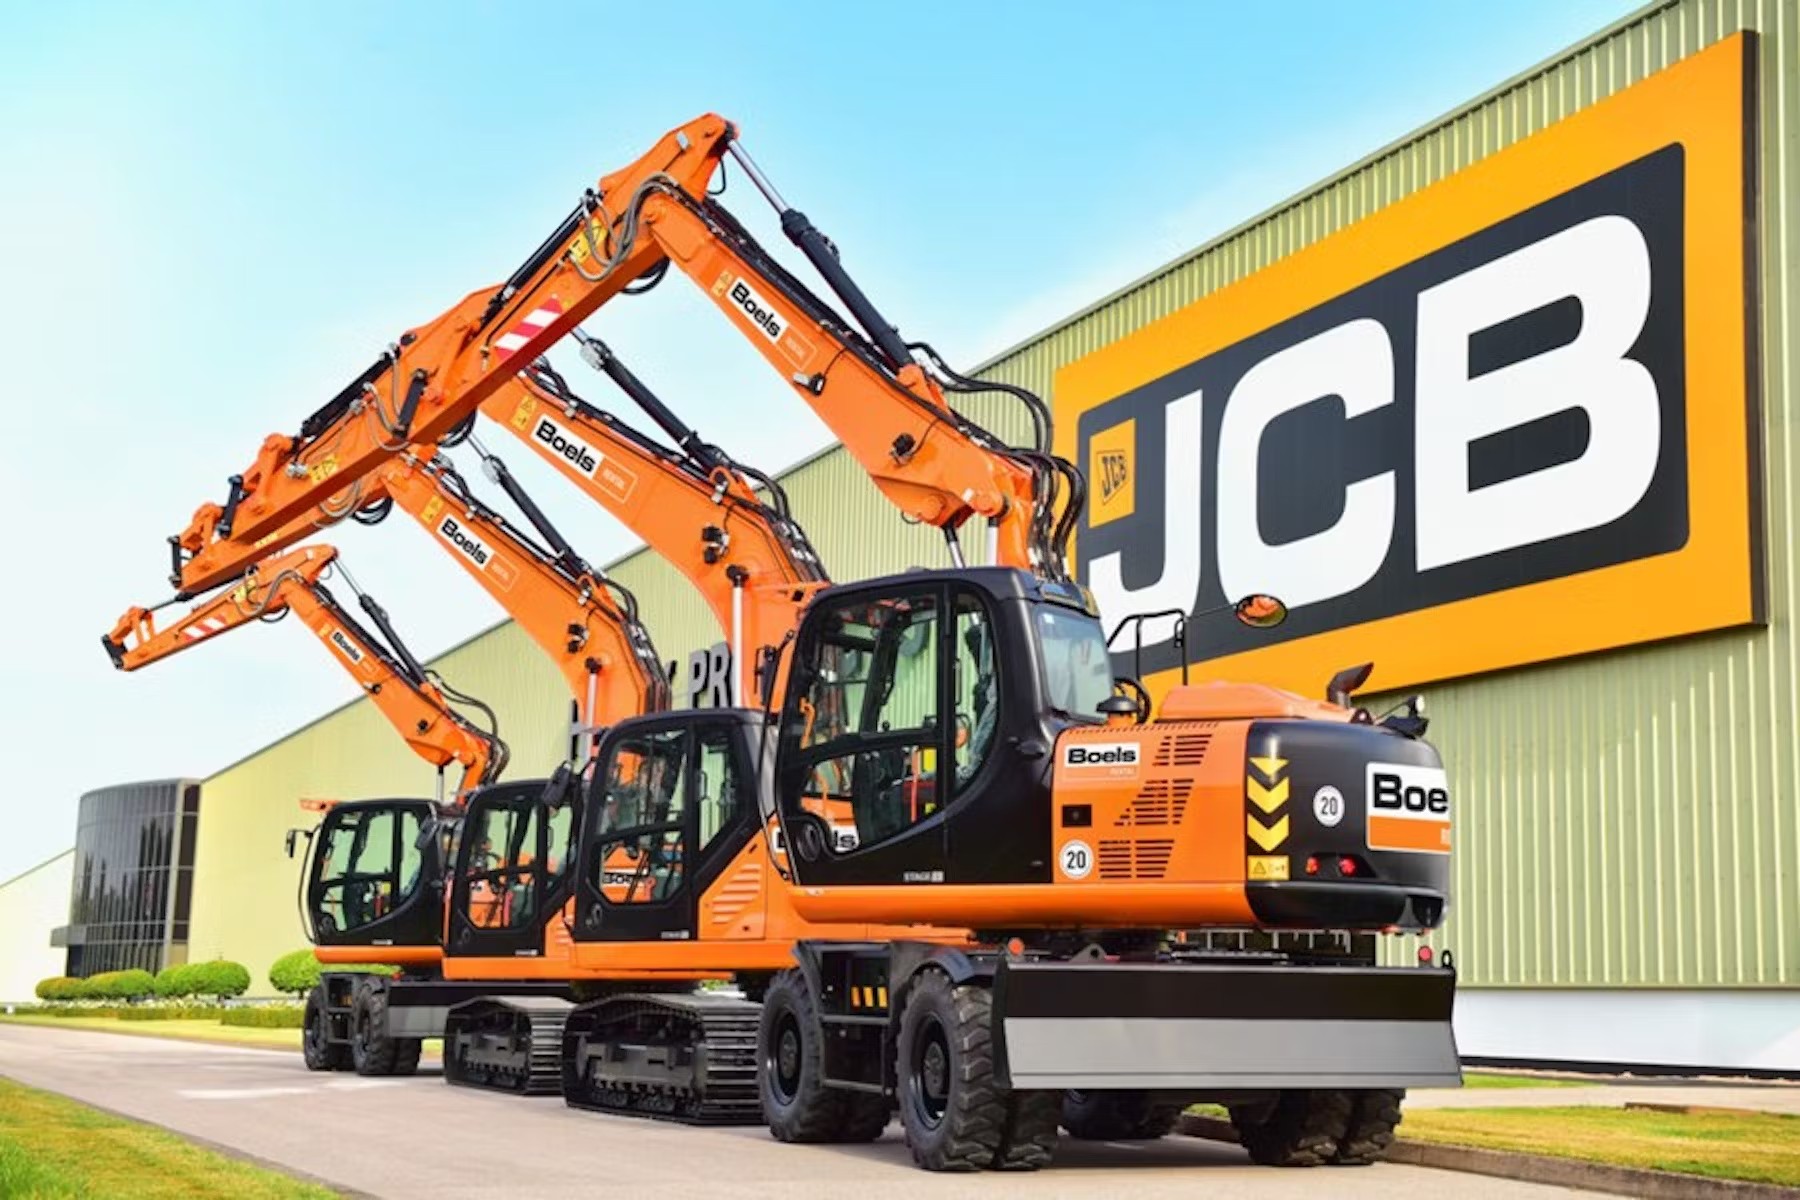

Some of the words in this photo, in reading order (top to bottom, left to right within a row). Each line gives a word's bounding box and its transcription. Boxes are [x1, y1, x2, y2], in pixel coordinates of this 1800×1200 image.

[731, 281, 781, 338] Boels
[536, 420, 596, 473] Boels
[1089, 214, 1662, 653] JCB
[1102, 455, 1126, 497] JCB
[441, 518, 488, 565] Boels
[1068, 746, 1137, 764] Boels
[1320, 795, 1339, 816] 20
[1066, 850, 1087, 869] 20
